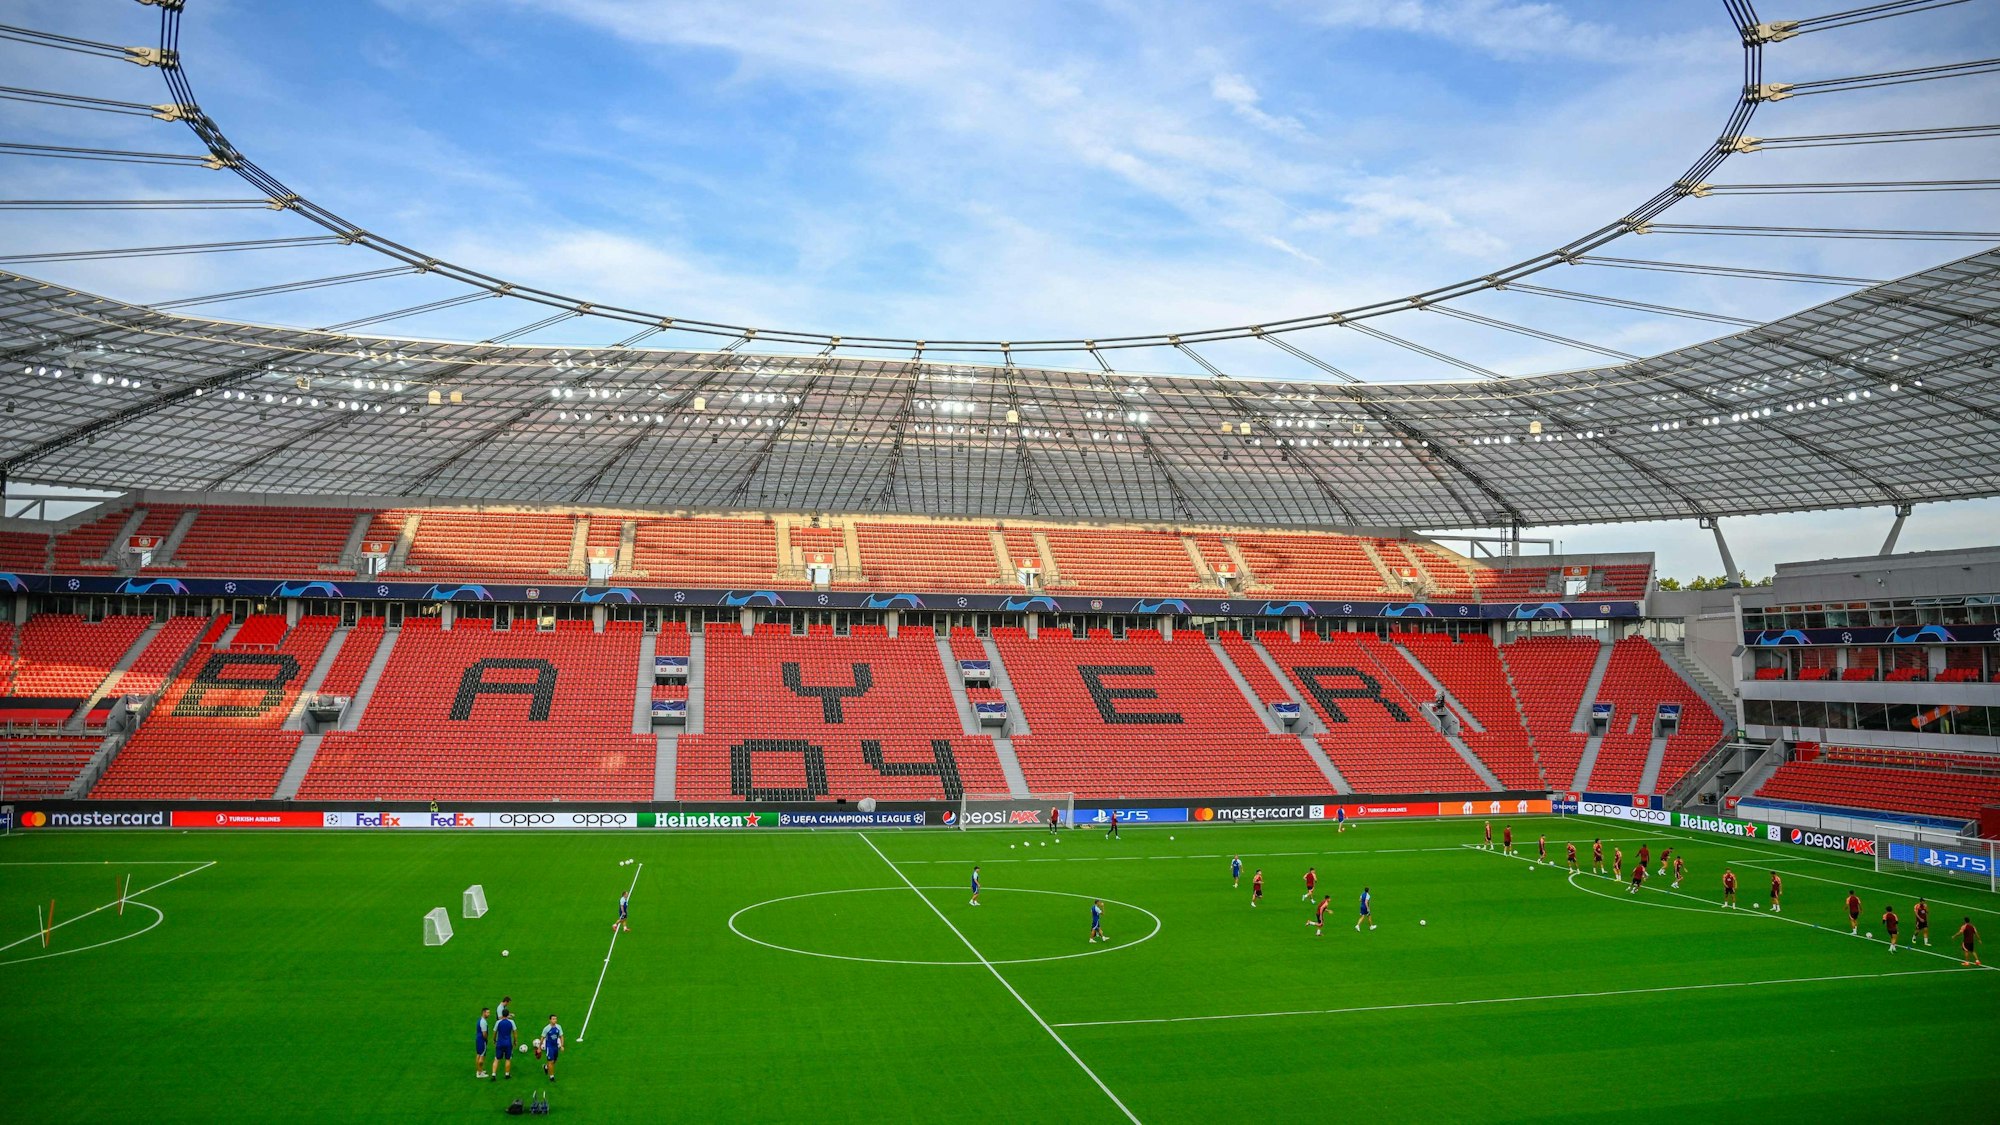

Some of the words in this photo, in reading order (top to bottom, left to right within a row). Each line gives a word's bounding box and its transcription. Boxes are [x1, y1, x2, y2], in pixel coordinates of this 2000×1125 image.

[730, 739, 963, 801] 04
[961, 809, 1007, 825] pepsi
[1009, 809, 1042, 825] MAX
[1115, 810, 1149, 821] PS5
[1217, 805, 1304, 820] mastercard
[1584, 803, 1621, 816] oppo
[1629, 808, 1666, 822] oppo
[51, 811, 163, 826] mastercard
[229, 815, 254, 823] TURKISH
[255, 815, 281, 823] AIRLINES
[356, 812, 401, 827] FedEx
[430, 812, 475, 827] FedEx
[499, 813, 555, 826] oppo
[572, 813, 628, 826] oppo
[654, 812, 743, 828] Heineken
[792, 814, 818, 824] UEFA
[819, 814, 874, 824] CHAMPIONS
[876, 813, 912, 823] LEAGUE
[1679, 813, 1745, 836] Heineken
[1804, 831, 1845, 850] pepsi
[1847, 836, 1876, 856] MAX
[1944, 853, 1987, 872] PS5
